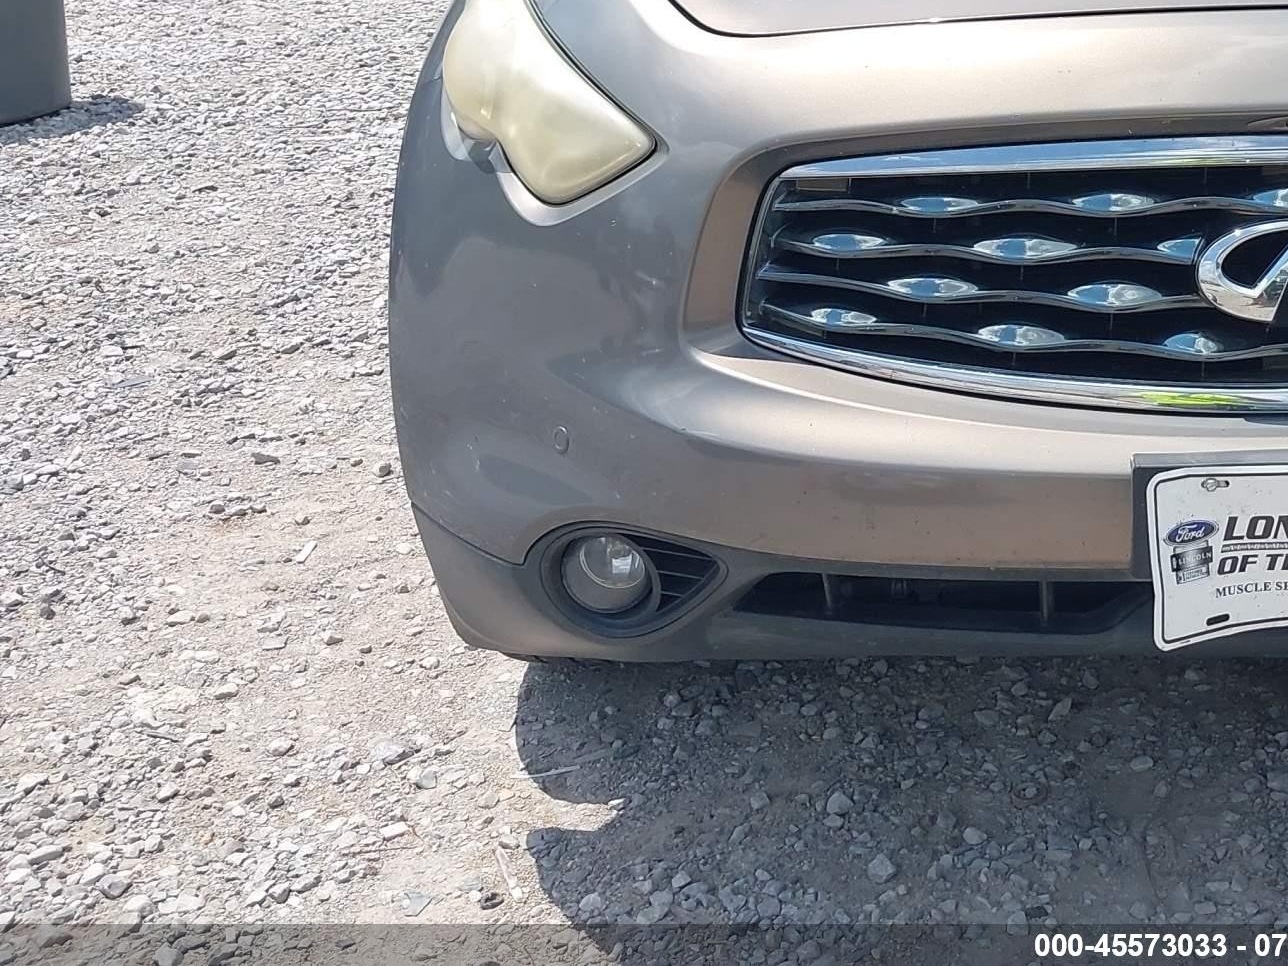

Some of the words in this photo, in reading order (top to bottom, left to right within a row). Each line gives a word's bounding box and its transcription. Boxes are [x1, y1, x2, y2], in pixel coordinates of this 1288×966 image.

[1175, 524, 1205, 542] Ford
[1178, 552, 1212, 566] LINCOLN
[1217, 553, 1258, 575] OF
[1215, 582, 1272, 599] MUSCLE
